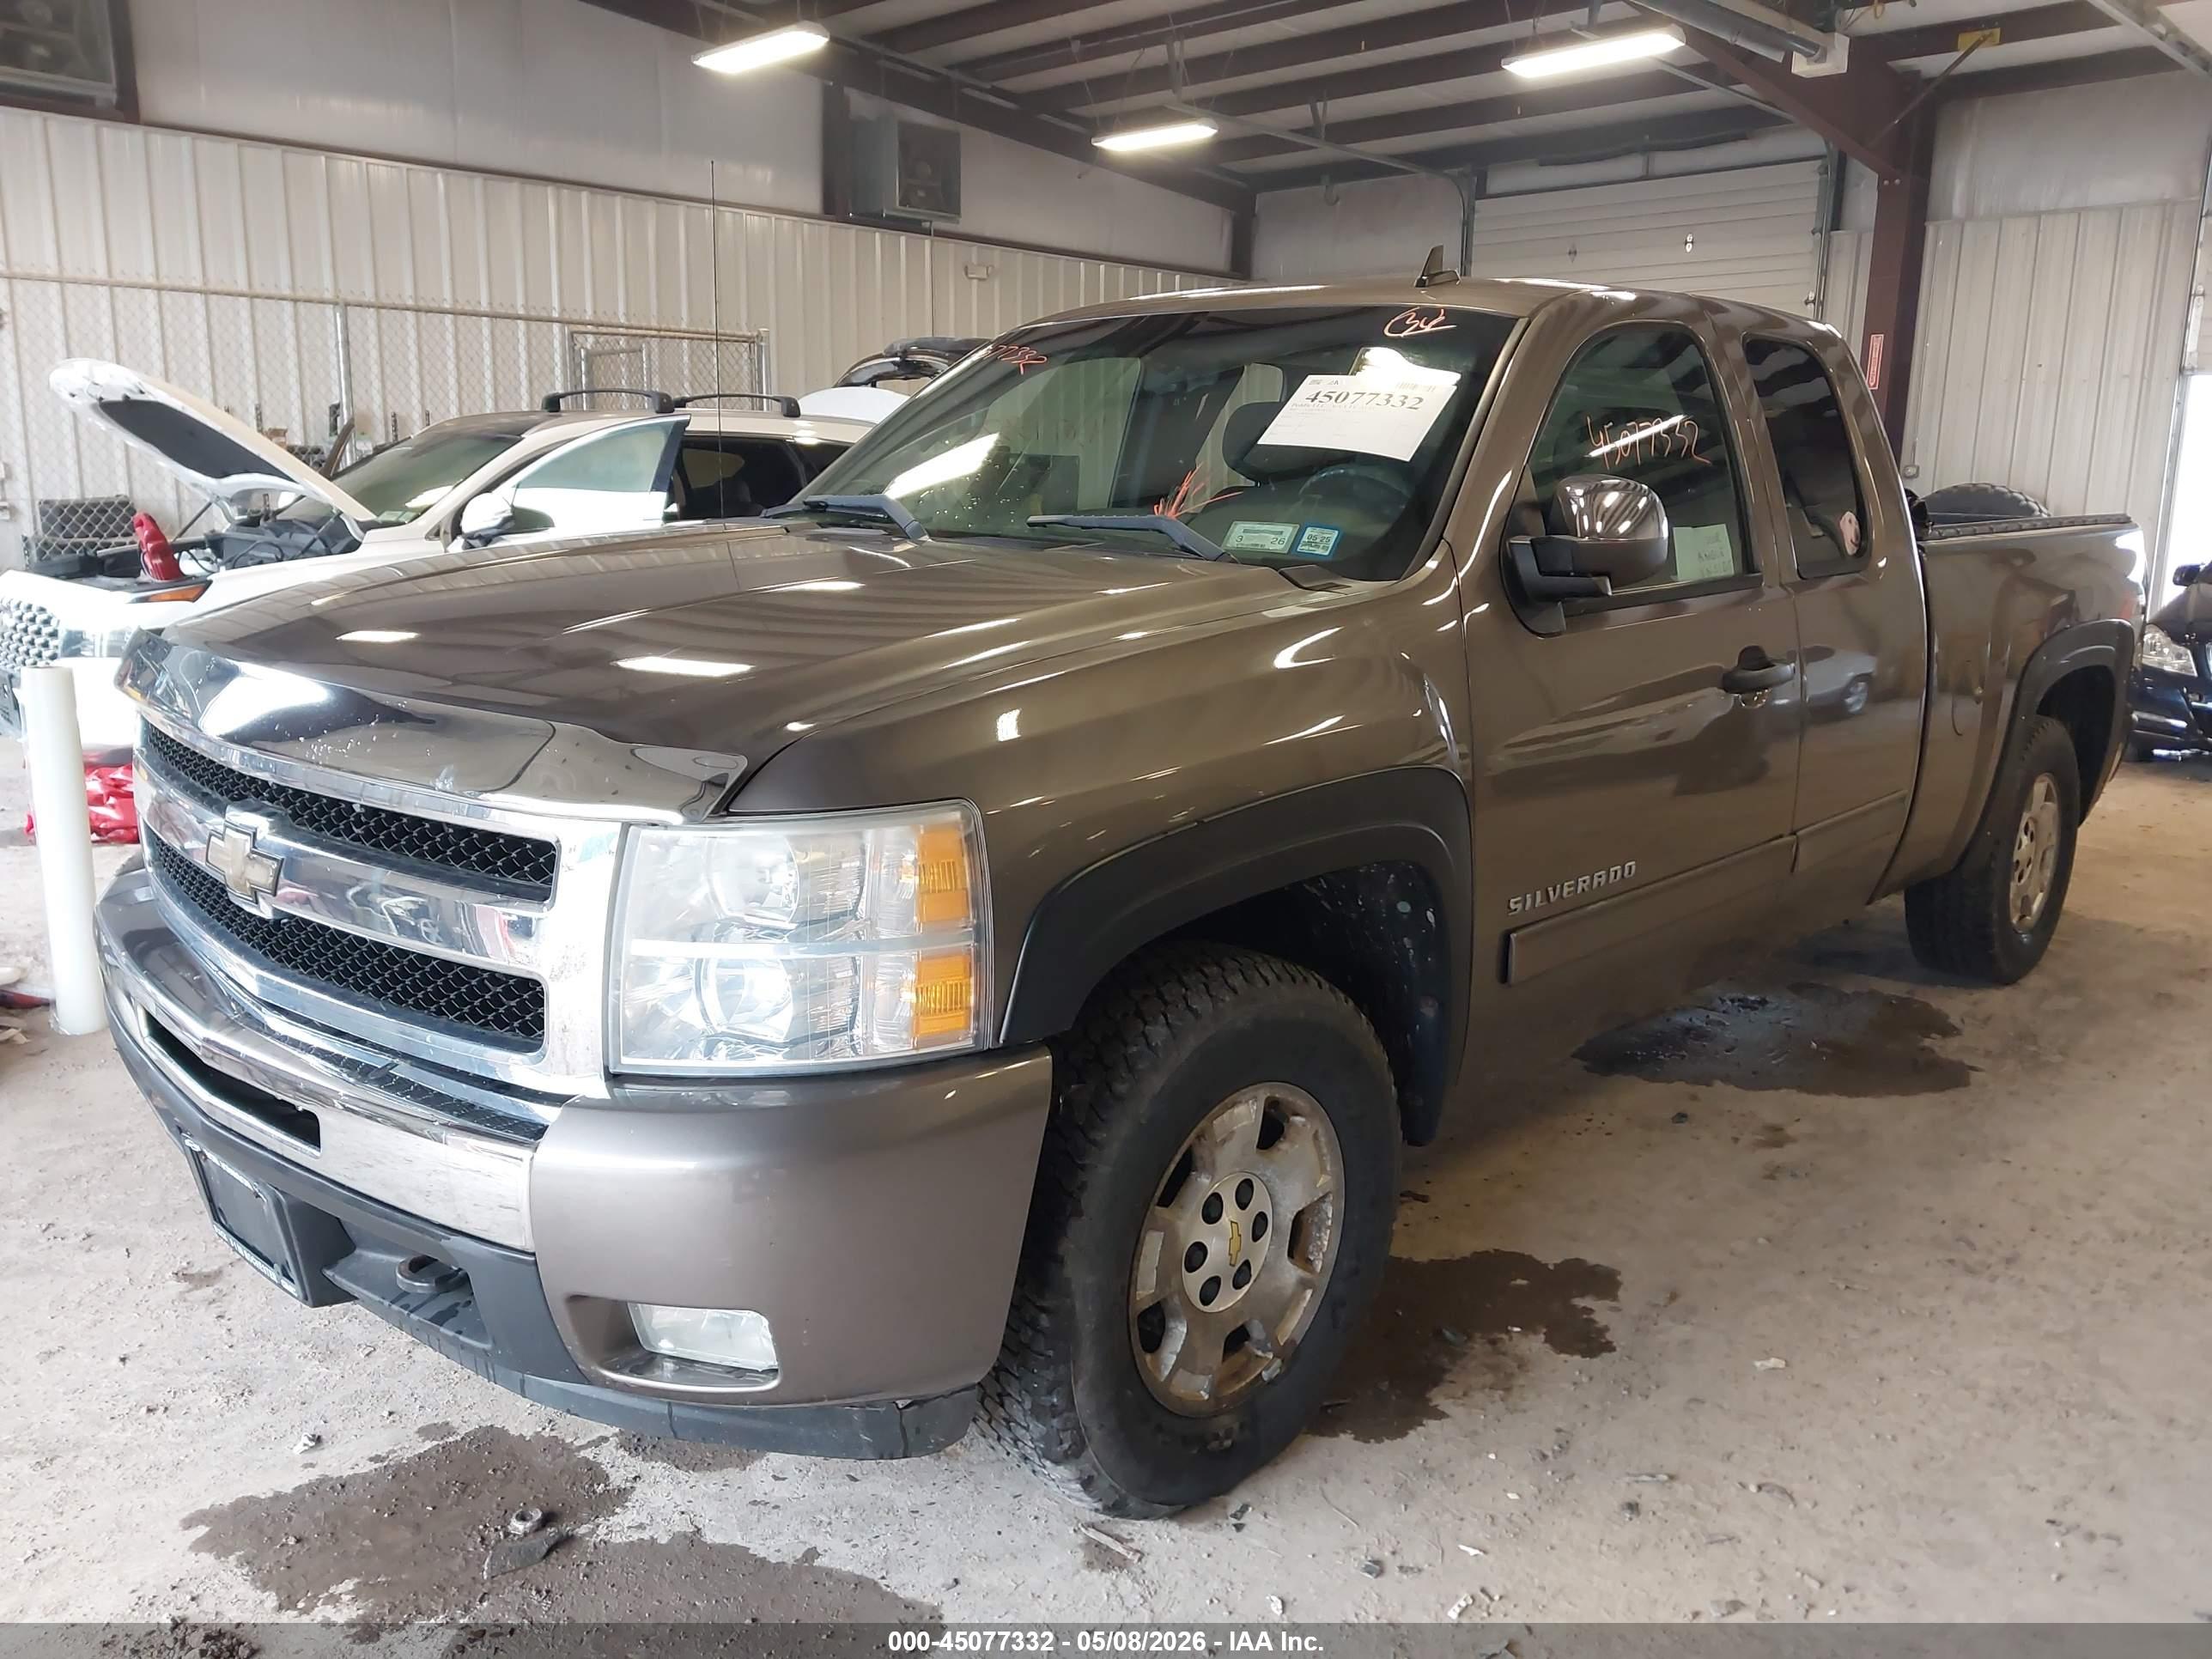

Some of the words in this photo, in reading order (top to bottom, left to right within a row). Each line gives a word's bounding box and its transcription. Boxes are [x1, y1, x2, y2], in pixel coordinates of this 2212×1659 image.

[1304, 389, 1425, 410] 45077332
[1271, 537, 1286, 545] 26
[1508, 860, 1637, 916] SILVERADO
